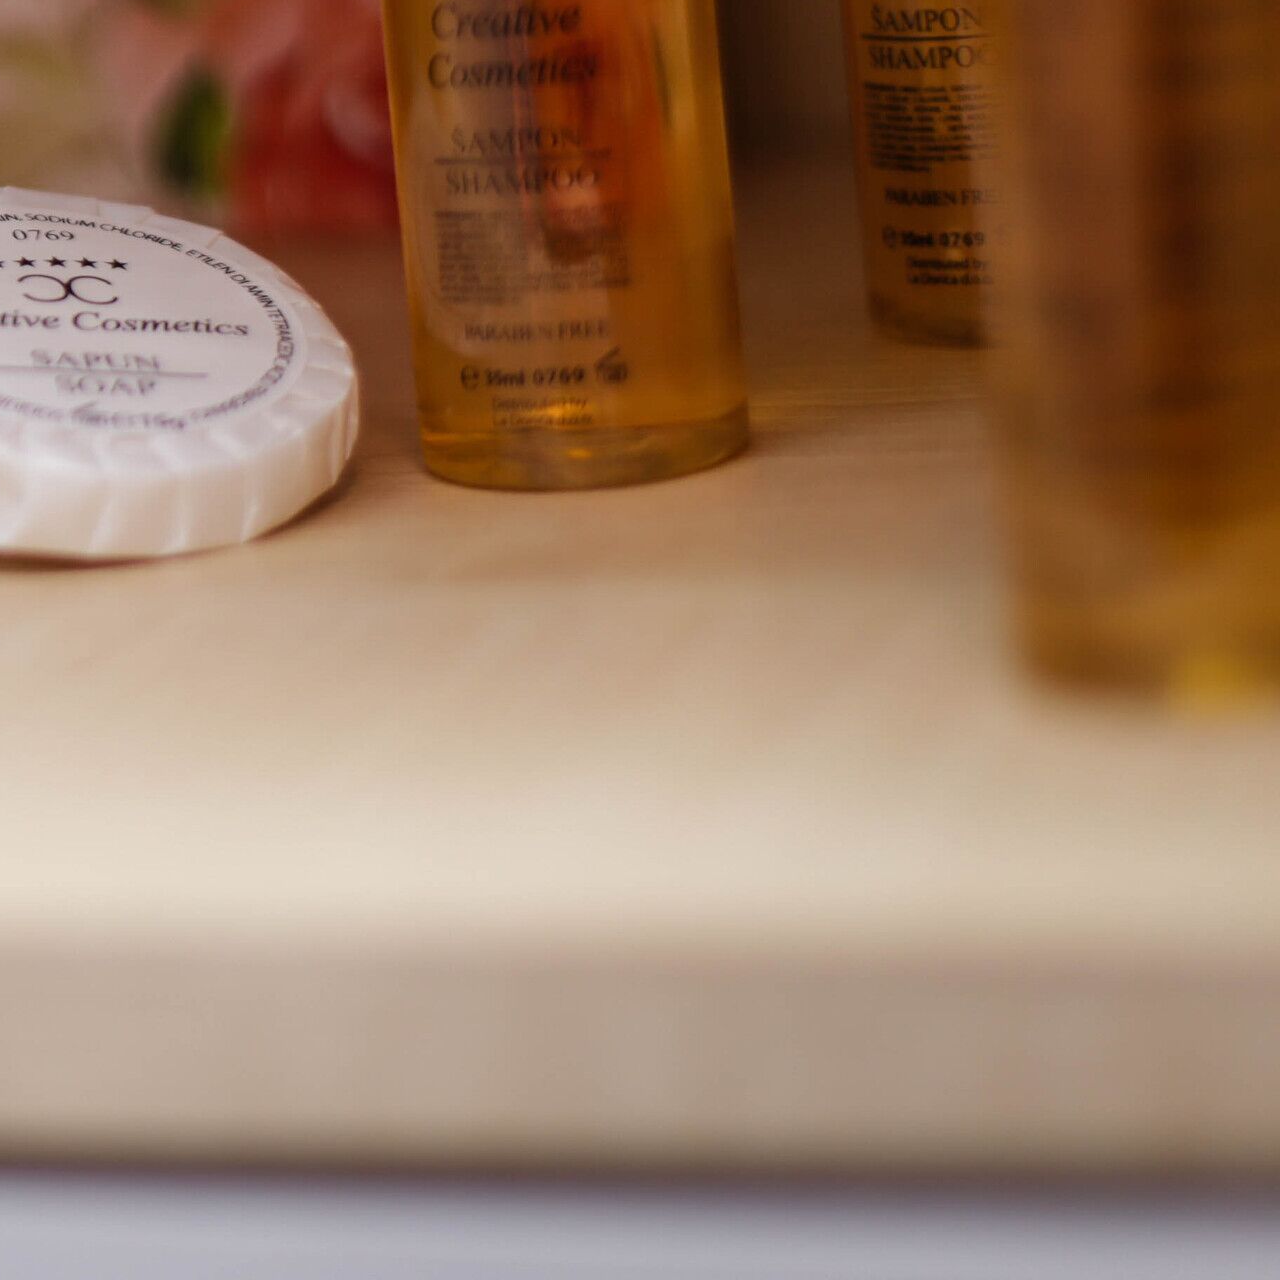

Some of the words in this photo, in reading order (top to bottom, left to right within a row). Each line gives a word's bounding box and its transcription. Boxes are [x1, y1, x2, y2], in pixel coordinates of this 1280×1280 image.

[432, 1, 582, 41] Creative
[12, 228, 75, 242] 0769
[24, 213, 96, 229] SODIUM
[185, 249, 235, 275] ETILEN
[72, 310, 249, 337] Cosmetics
